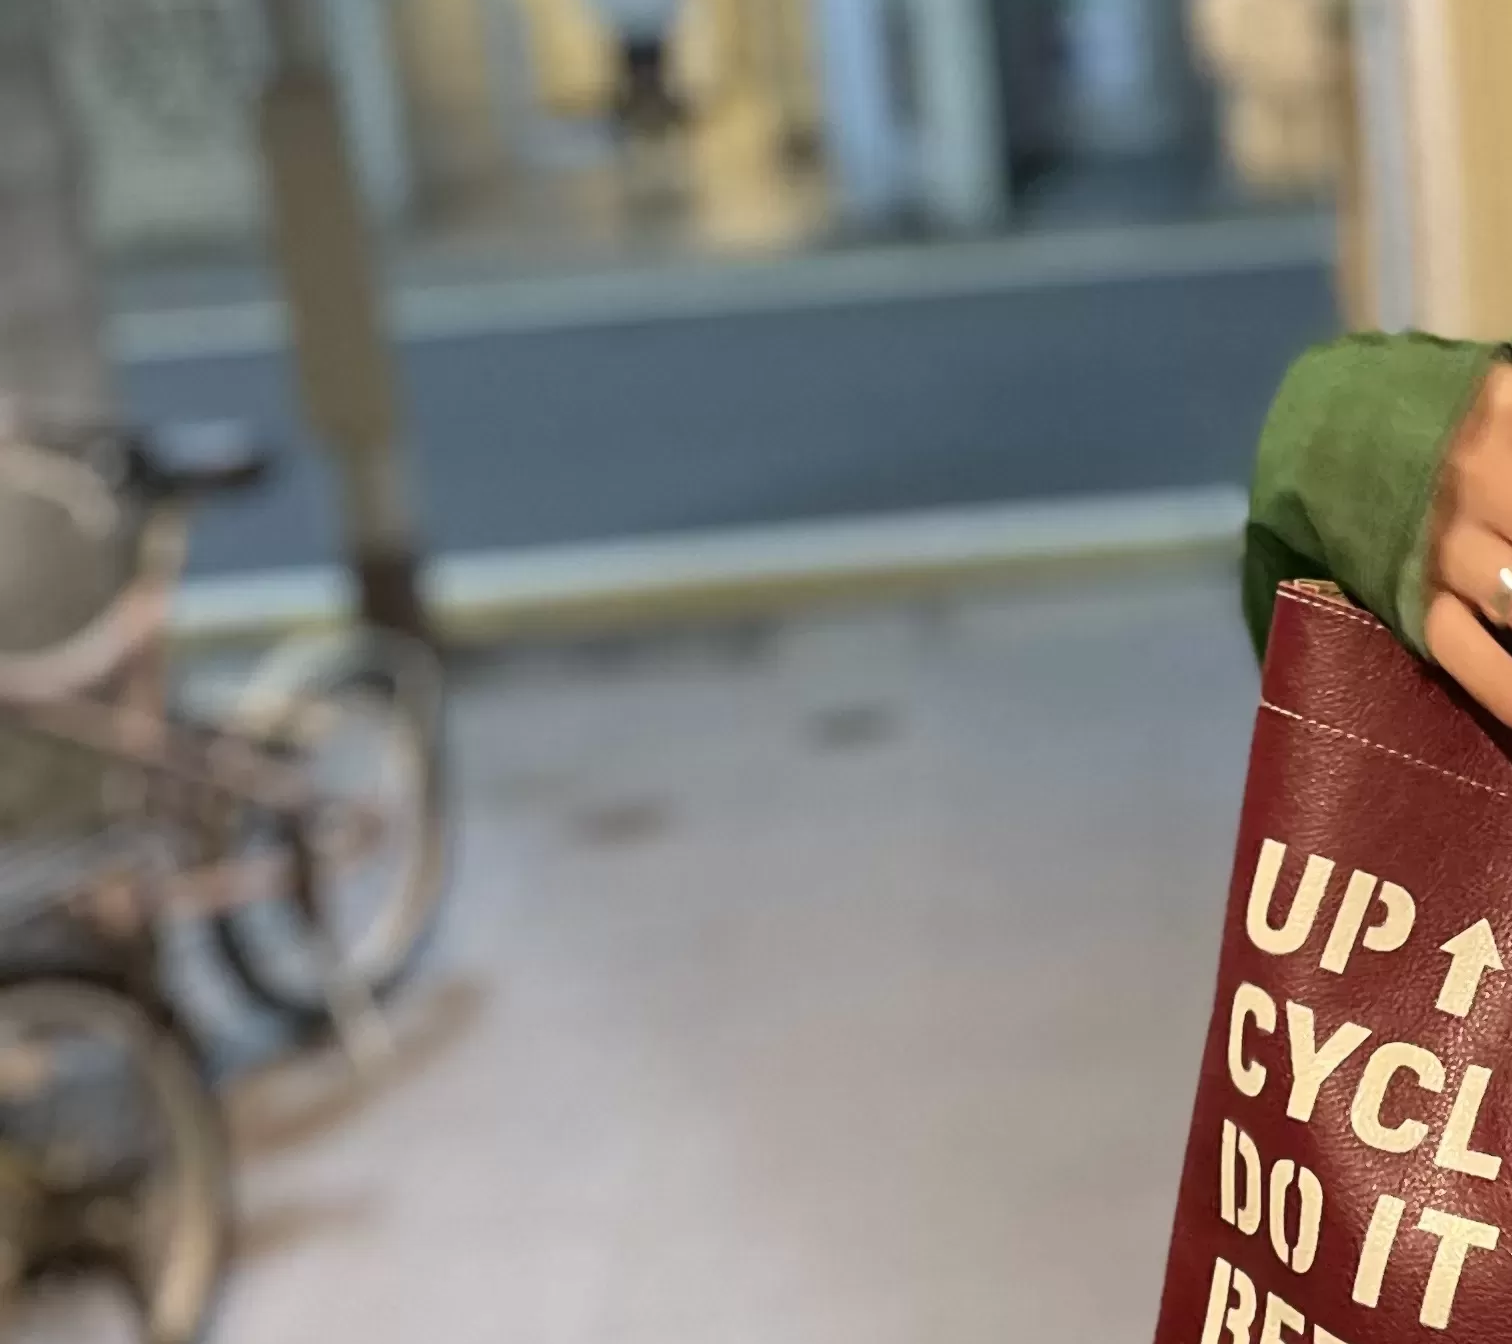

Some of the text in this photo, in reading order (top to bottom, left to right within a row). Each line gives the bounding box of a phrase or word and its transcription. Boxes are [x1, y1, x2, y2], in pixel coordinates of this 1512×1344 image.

[1246, 839, 1416, 975] UP
[1220, 1119, 1500, 1330] DO IT
